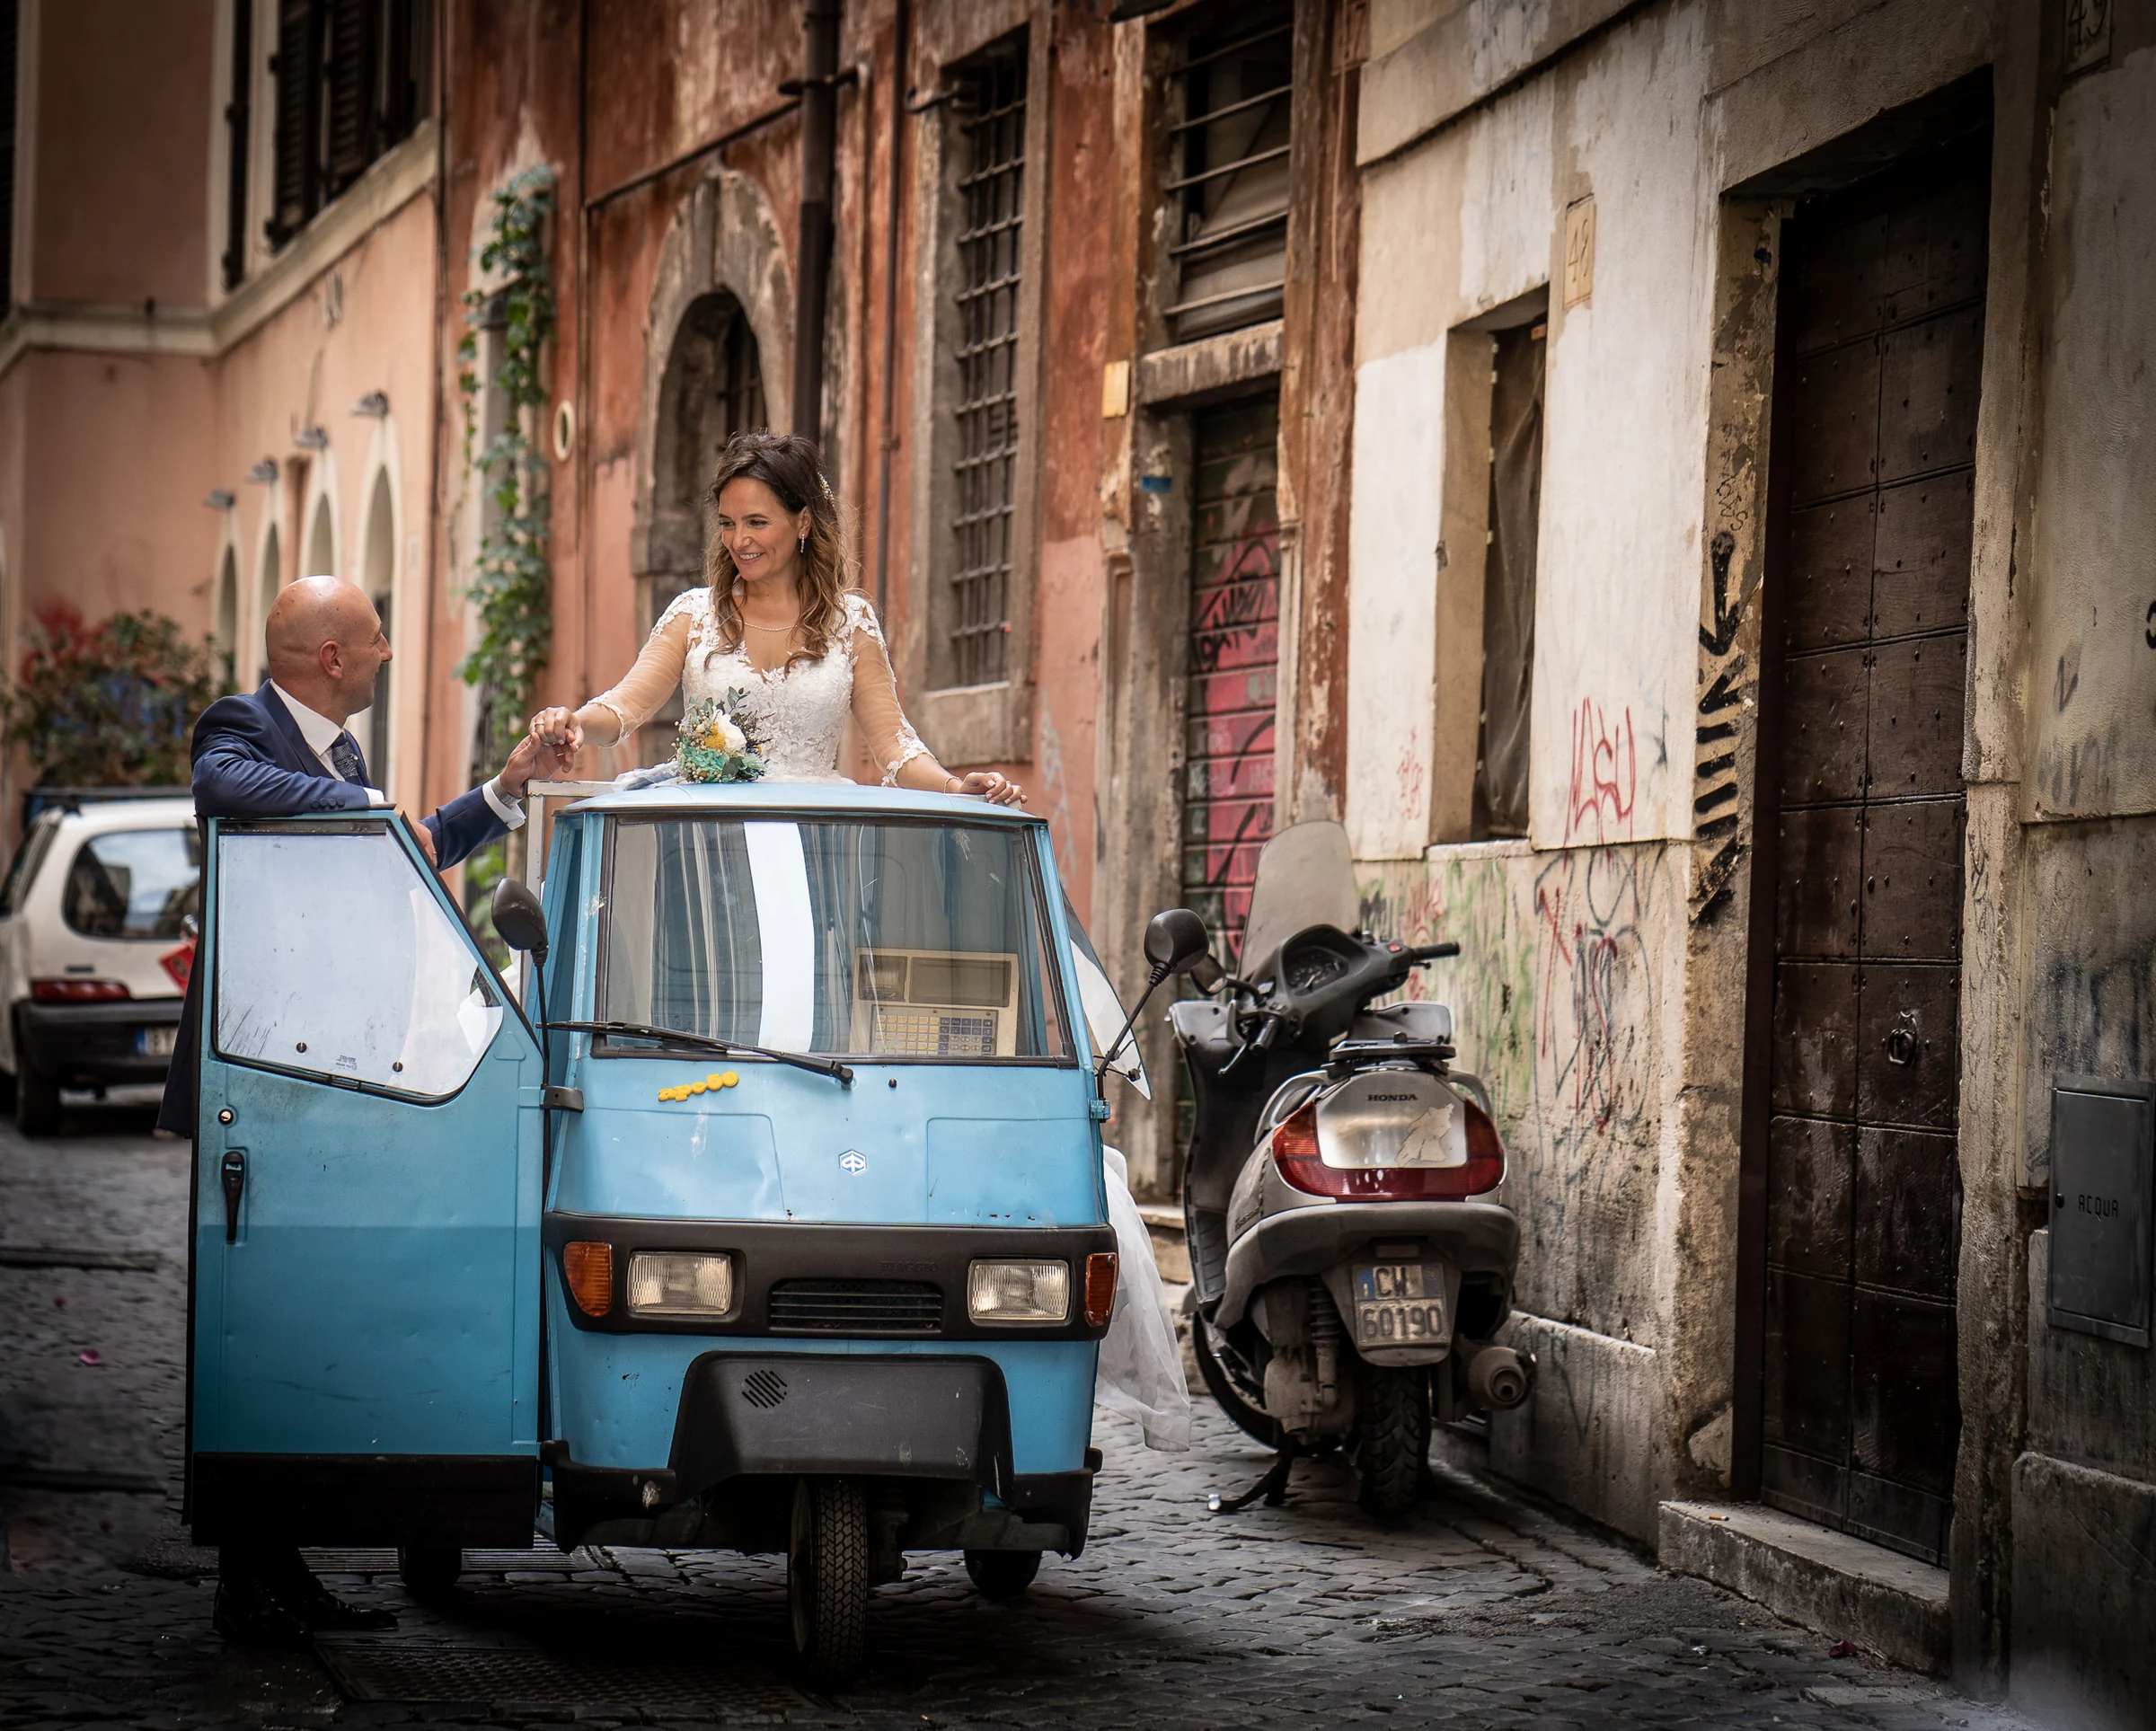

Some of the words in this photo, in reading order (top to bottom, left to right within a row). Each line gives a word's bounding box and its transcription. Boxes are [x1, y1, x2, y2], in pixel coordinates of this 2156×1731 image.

[1366, 1093, 1419, 1102] HONDA
[2077, 1194, 2119, 1222] ACQUA
[1362, 1304, 1443, 1338] 60190
